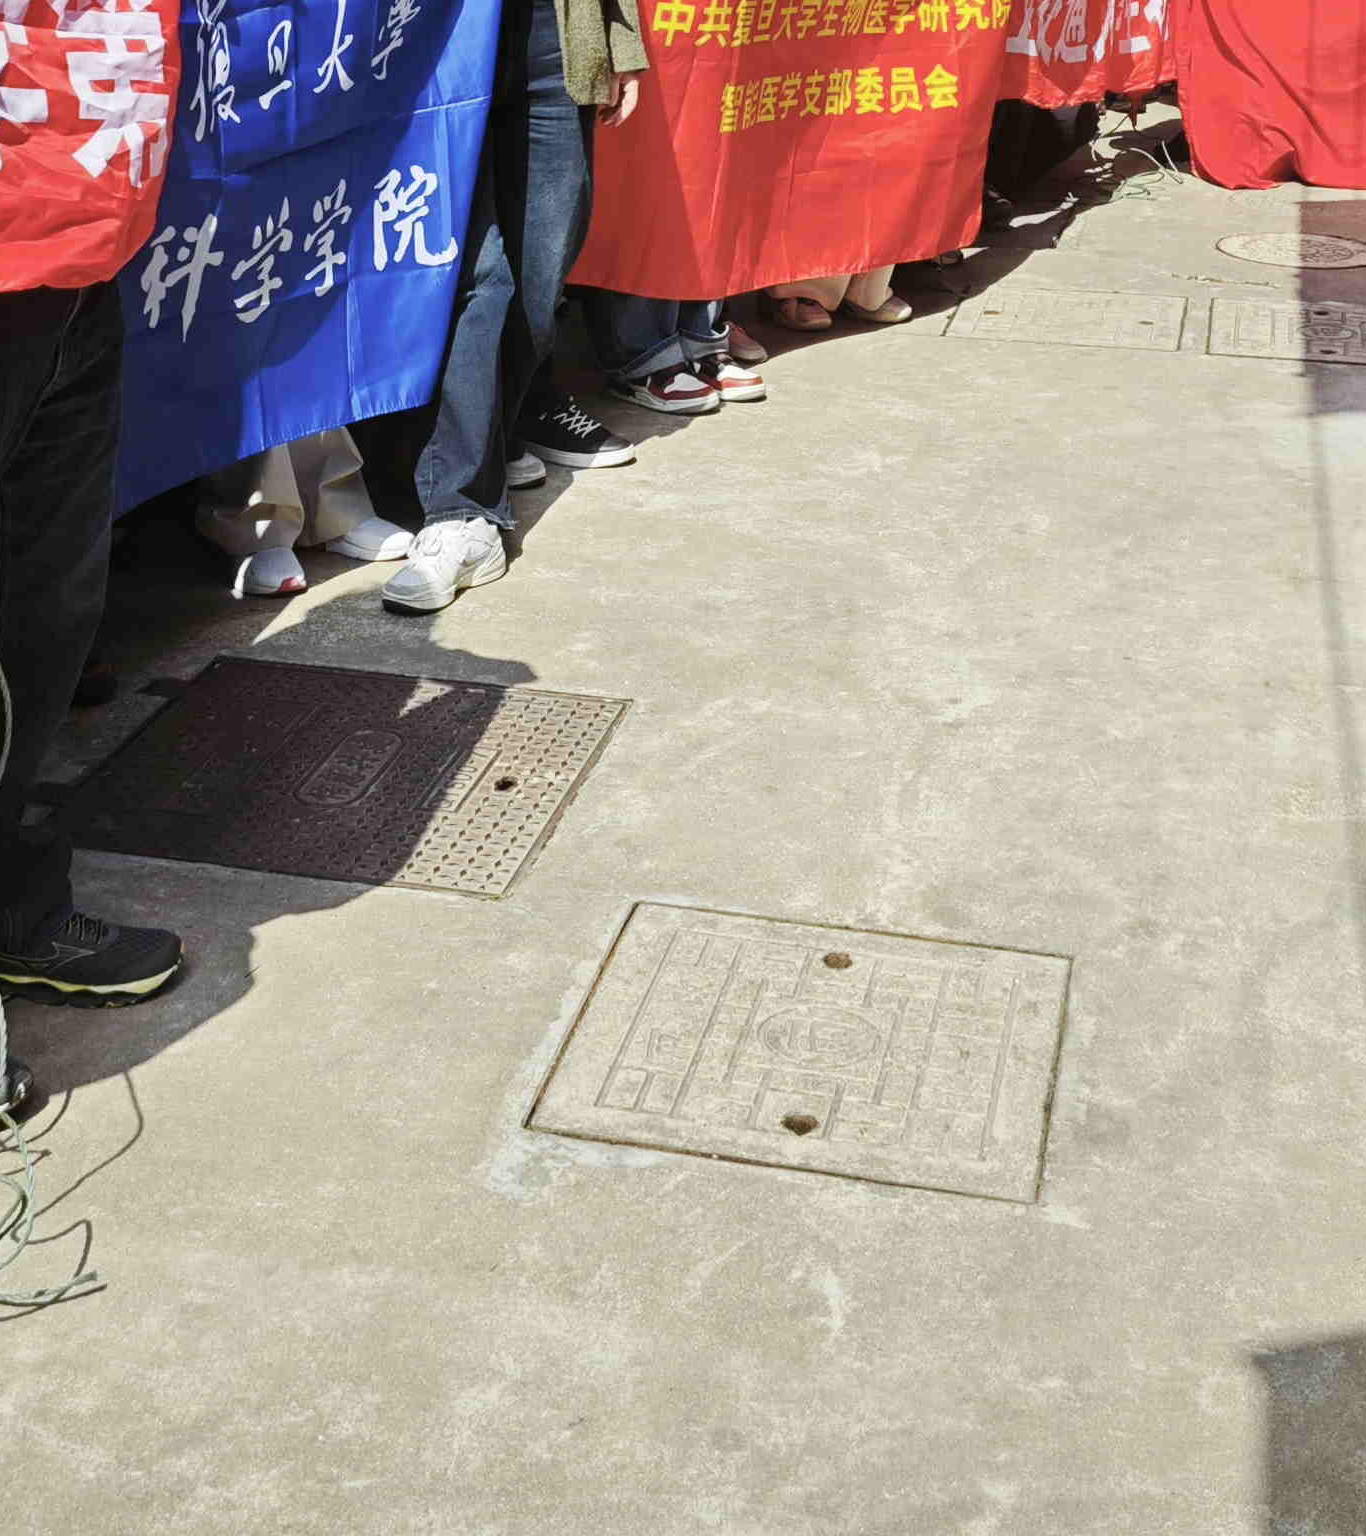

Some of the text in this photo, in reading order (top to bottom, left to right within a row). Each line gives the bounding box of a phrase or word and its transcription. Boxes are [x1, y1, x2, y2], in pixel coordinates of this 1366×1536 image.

[719, 64, 959, 134] 智能医学支部委员会
[140, 165, 459, 343] 科学学院
